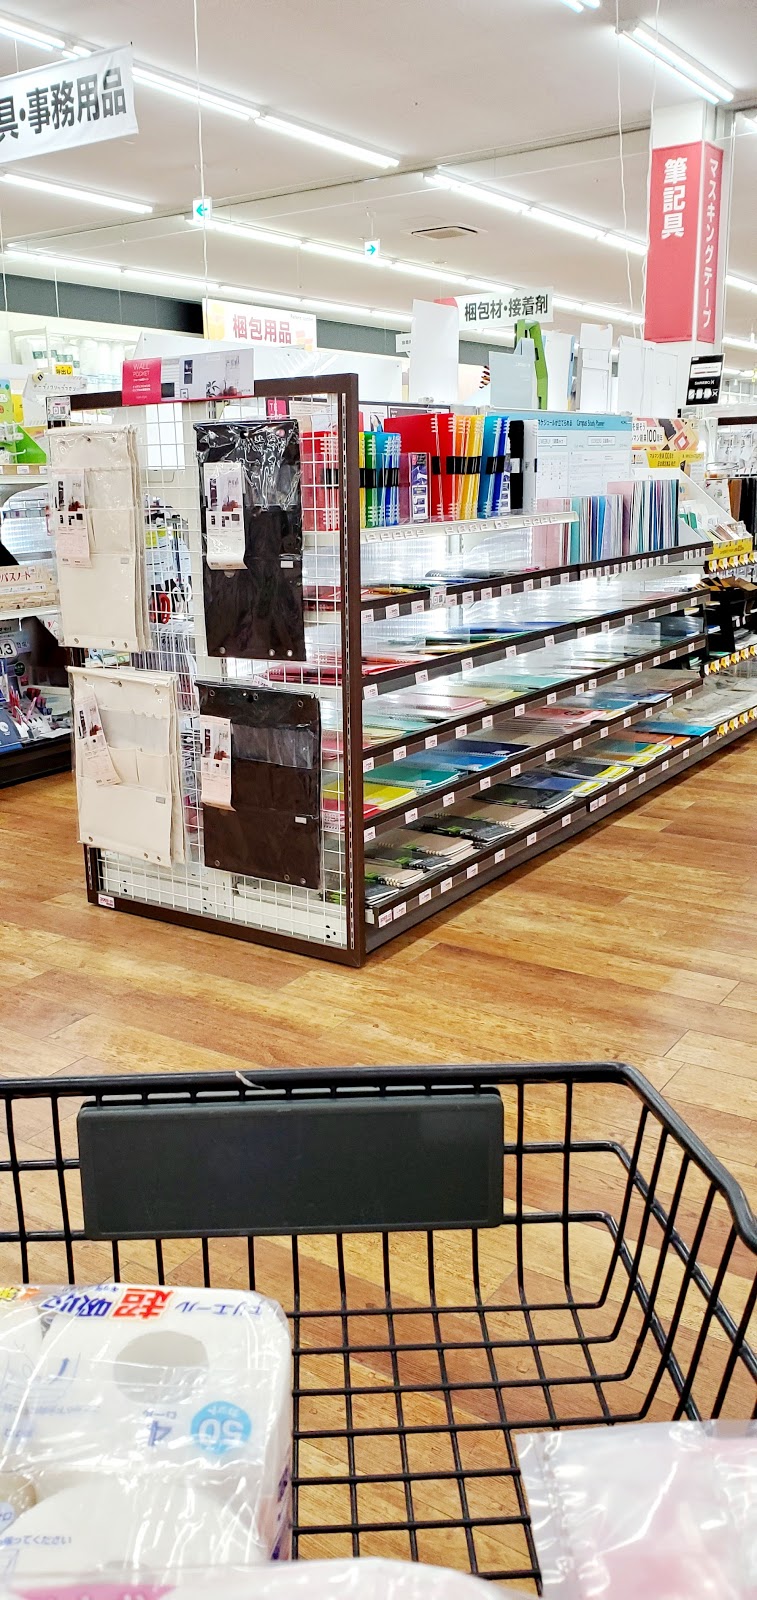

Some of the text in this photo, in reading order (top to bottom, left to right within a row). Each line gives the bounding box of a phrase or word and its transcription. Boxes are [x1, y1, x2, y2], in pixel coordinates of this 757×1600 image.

[0, 67, 126, 143] 具・事務用品
[661, 156, 688, 240] 筆記具
[702, 158, 719, 328] マスキングテープ
[464, 294, 549, 322] 梱包材・接着剤
[232, 314, 292, 344] 梱包用品
[133, 362, 150, 370] WALL
[148, 1420, 172, 1447] 4
[198, 1418, 244, 1447] 50
